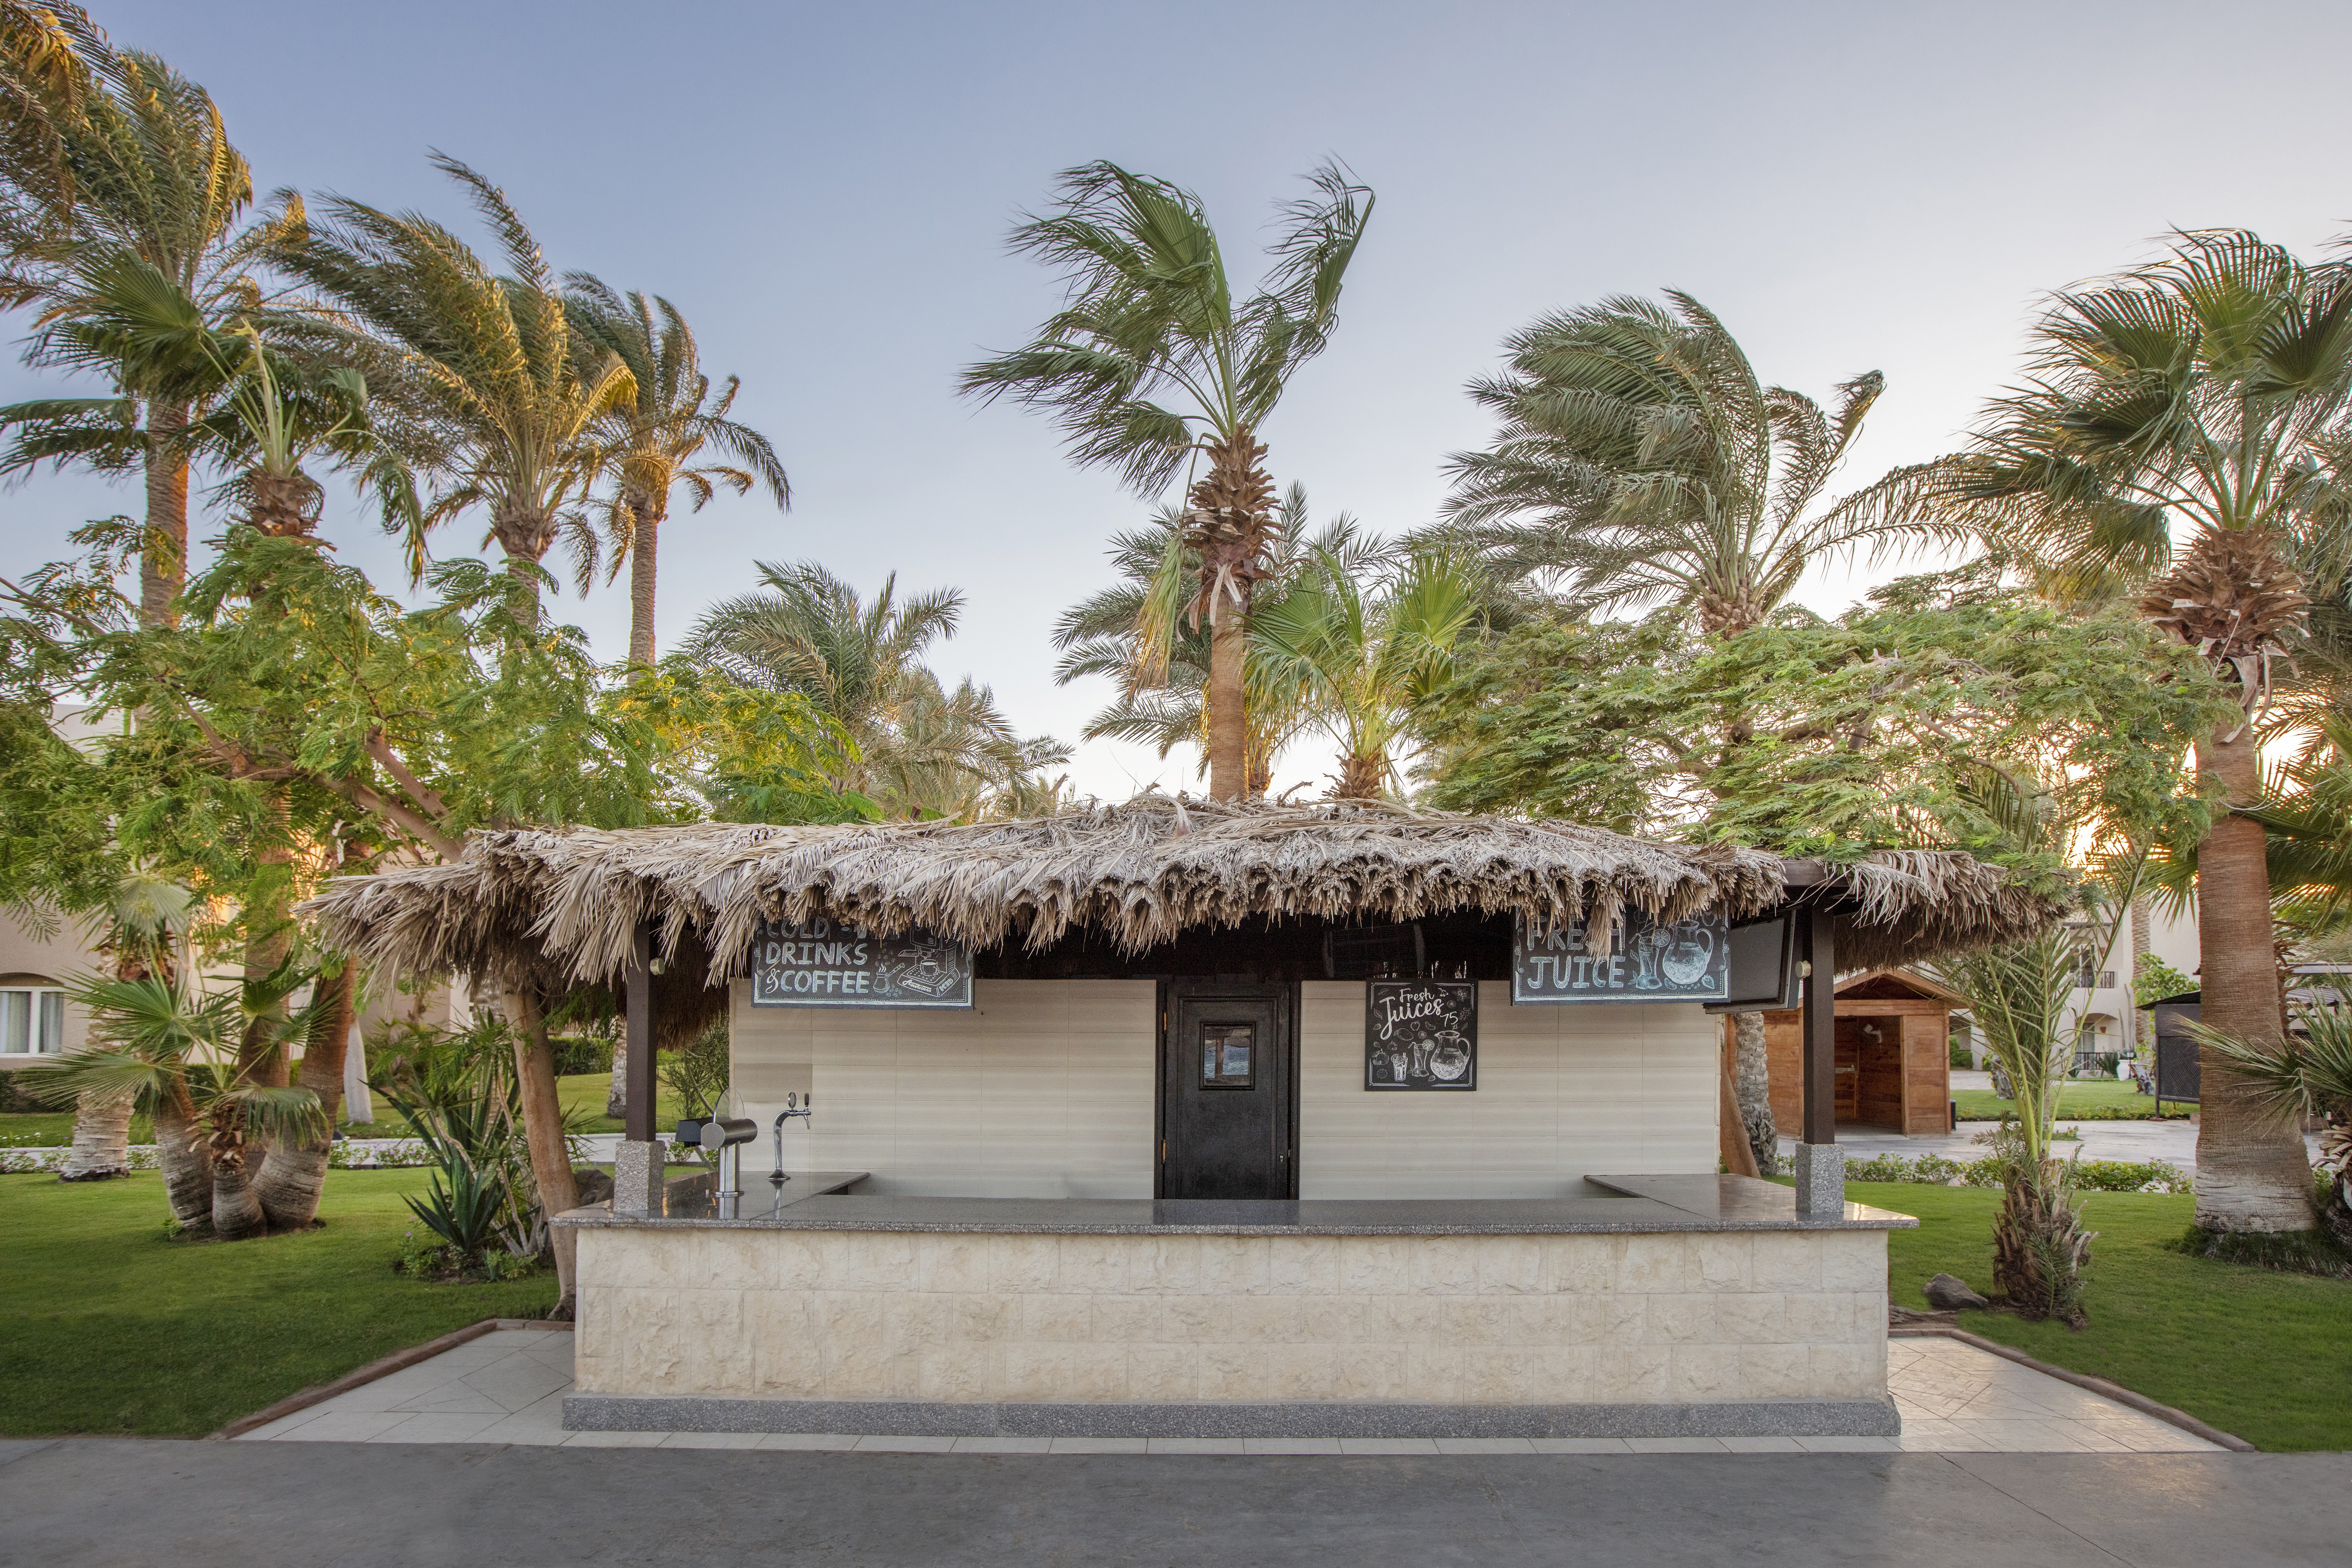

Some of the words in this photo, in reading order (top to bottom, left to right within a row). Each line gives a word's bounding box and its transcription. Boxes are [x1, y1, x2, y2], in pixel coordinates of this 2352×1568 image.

[767, 916, 829, 938] COLD
[1528, 915, 1626, 951] FREH
[766, 941, 868, 965] DRINKS
[1527, 955, 1626, 990] JUICE
[902, 979, 932, 993] Americano
[939, 978, 953, 992] ICED
[1399, 987, 1435, 1002] Fresh
[1379, 996, 1444, 1040] Juices
[1440, 1011, 1458, 1027] 75
